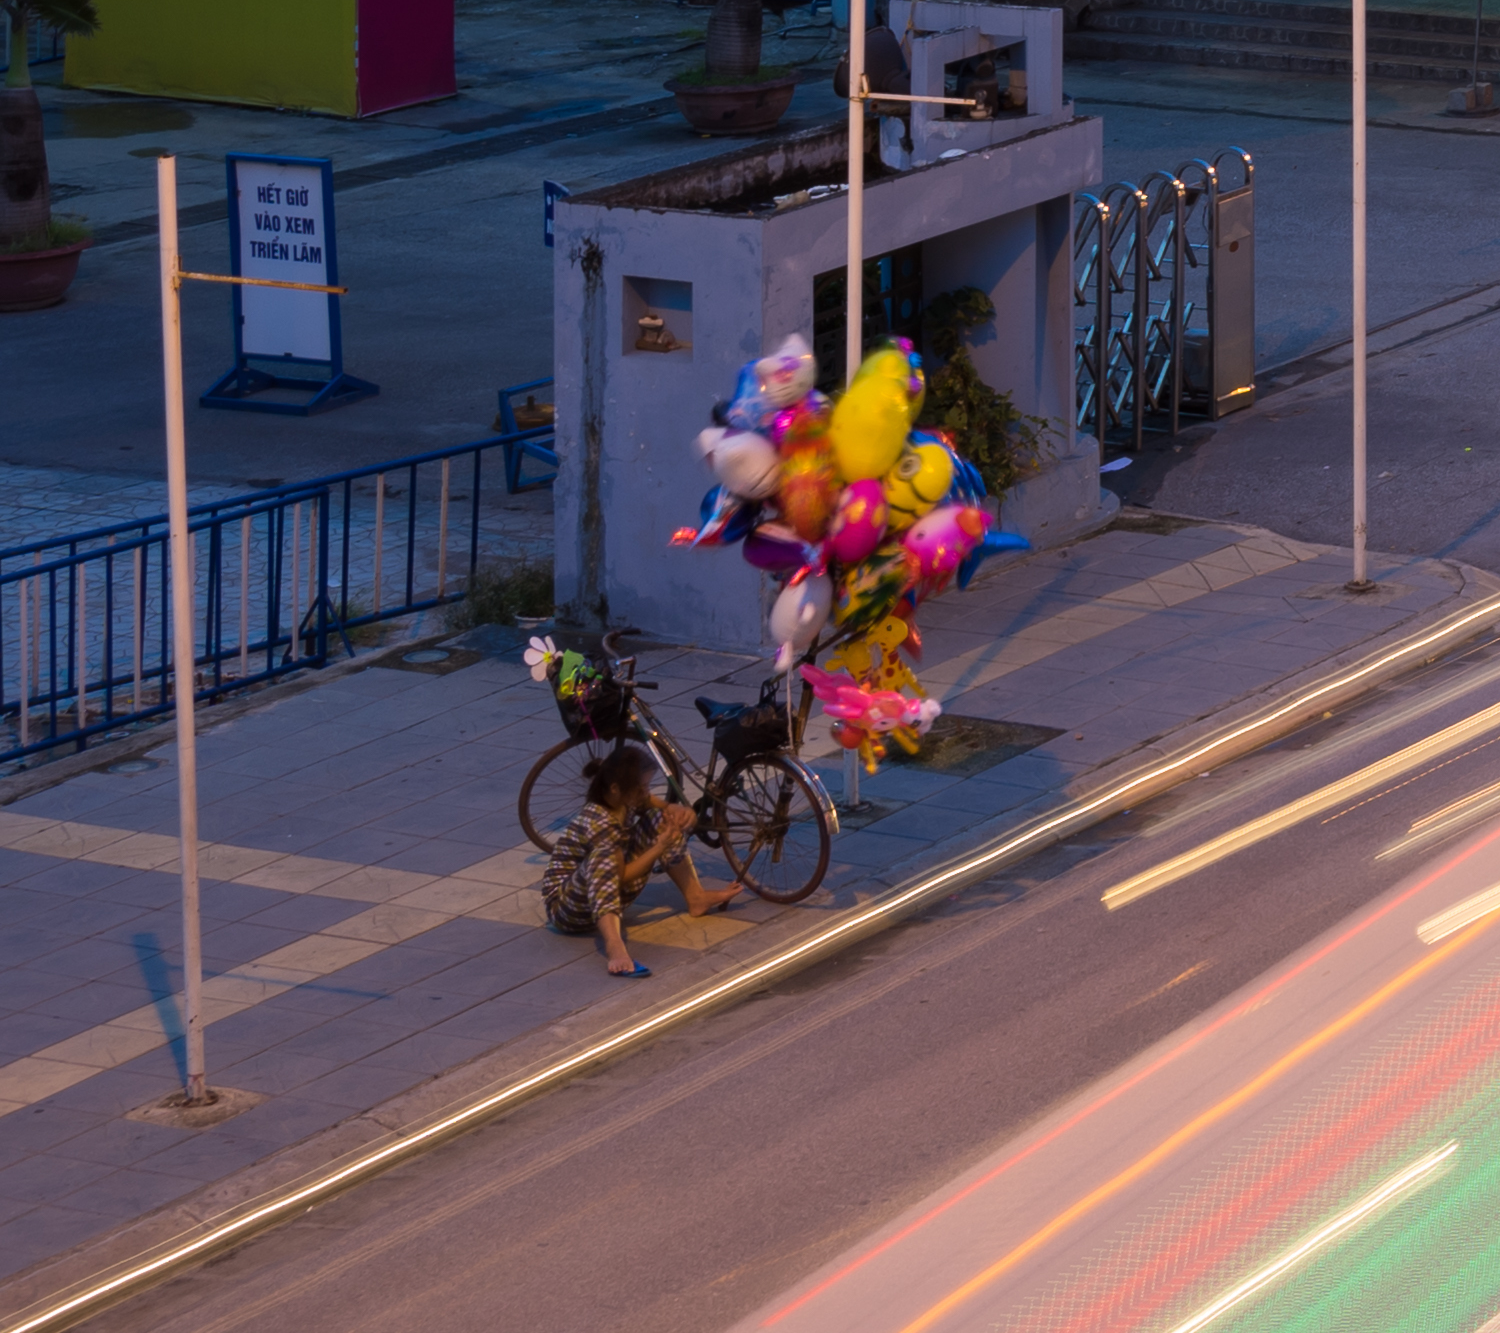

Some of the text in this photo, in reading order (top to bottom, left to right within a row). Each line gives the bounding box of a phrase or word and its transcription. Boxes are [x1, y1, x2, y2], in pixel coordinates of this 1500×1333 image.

[257, 182, 309, 207] HẾT GIỜ
[254, 210, 315, 236] VÀO XEM
[250, 235, 322, 264] TRIỂN LÃM
